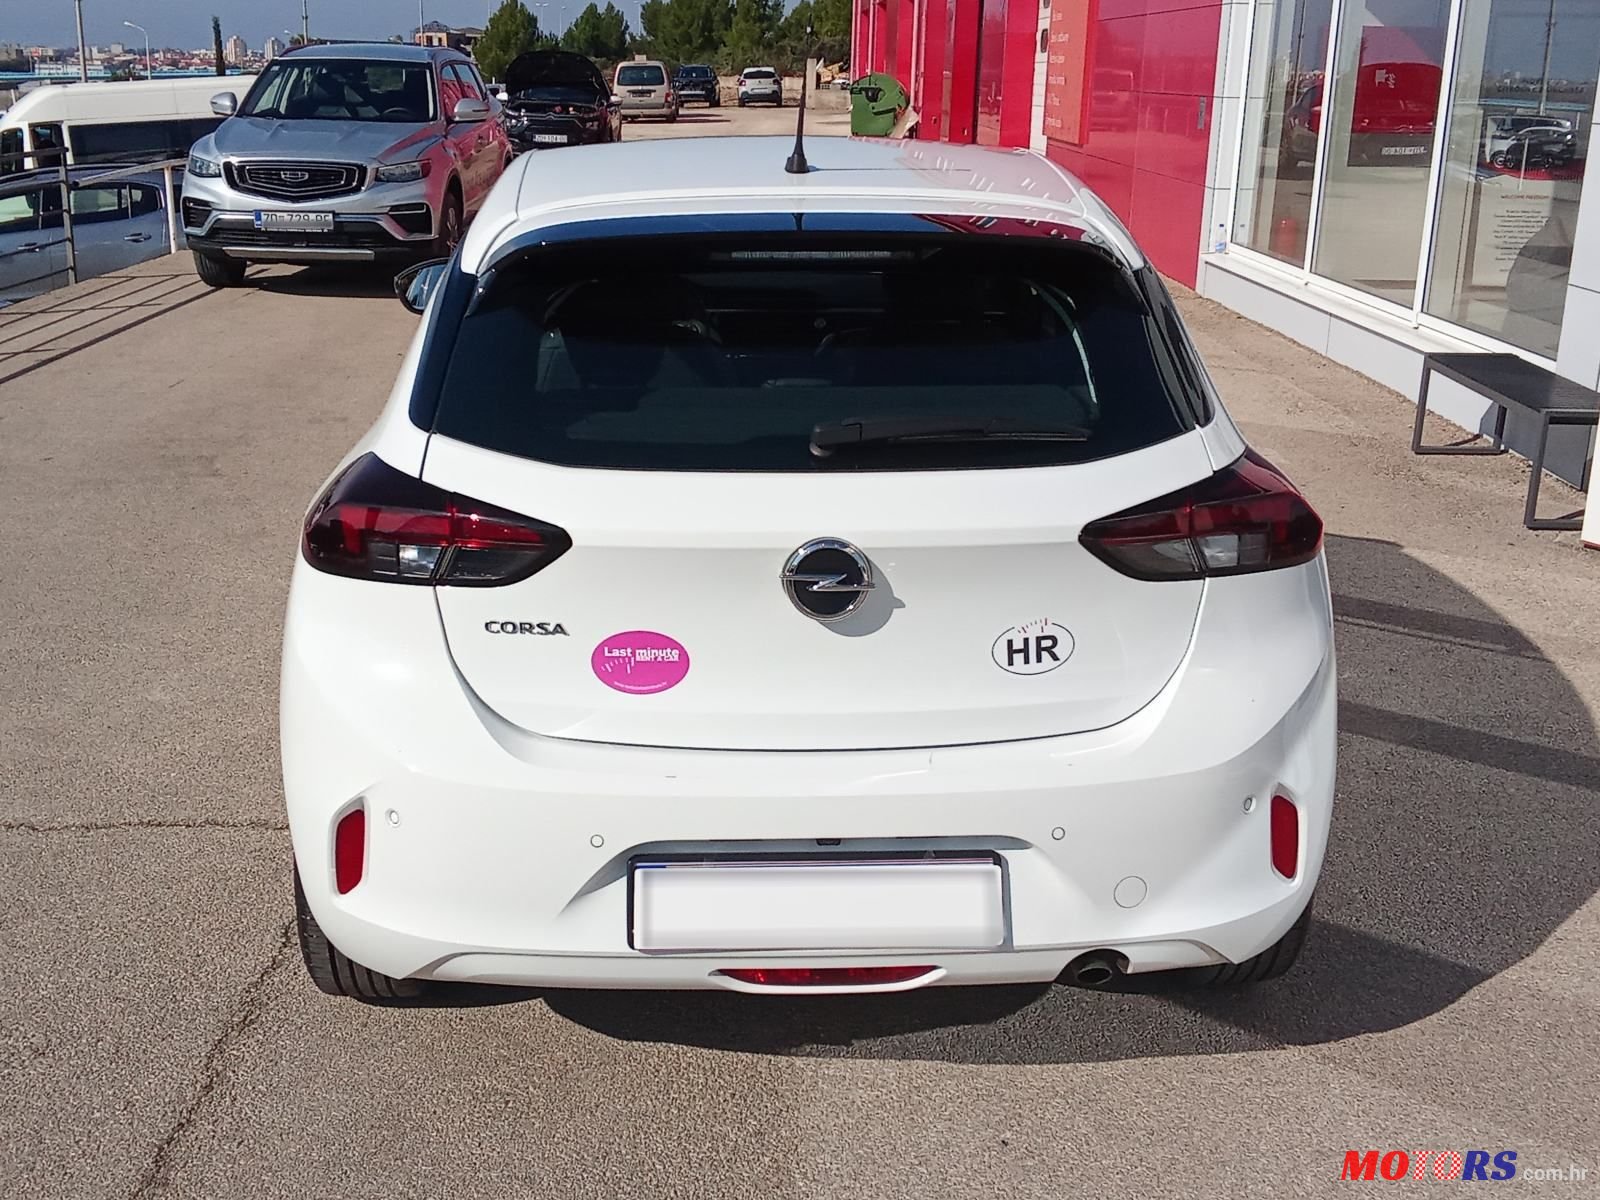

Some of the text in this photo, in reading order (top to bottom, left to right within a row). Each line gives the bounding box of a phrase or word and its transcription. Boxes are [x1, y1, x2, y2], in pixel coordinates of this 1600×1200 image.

[484, 621, 570, 636] CORSA
[604, 646, 680, 657] Last minute
[1007, 634, 1061, 667] HR
